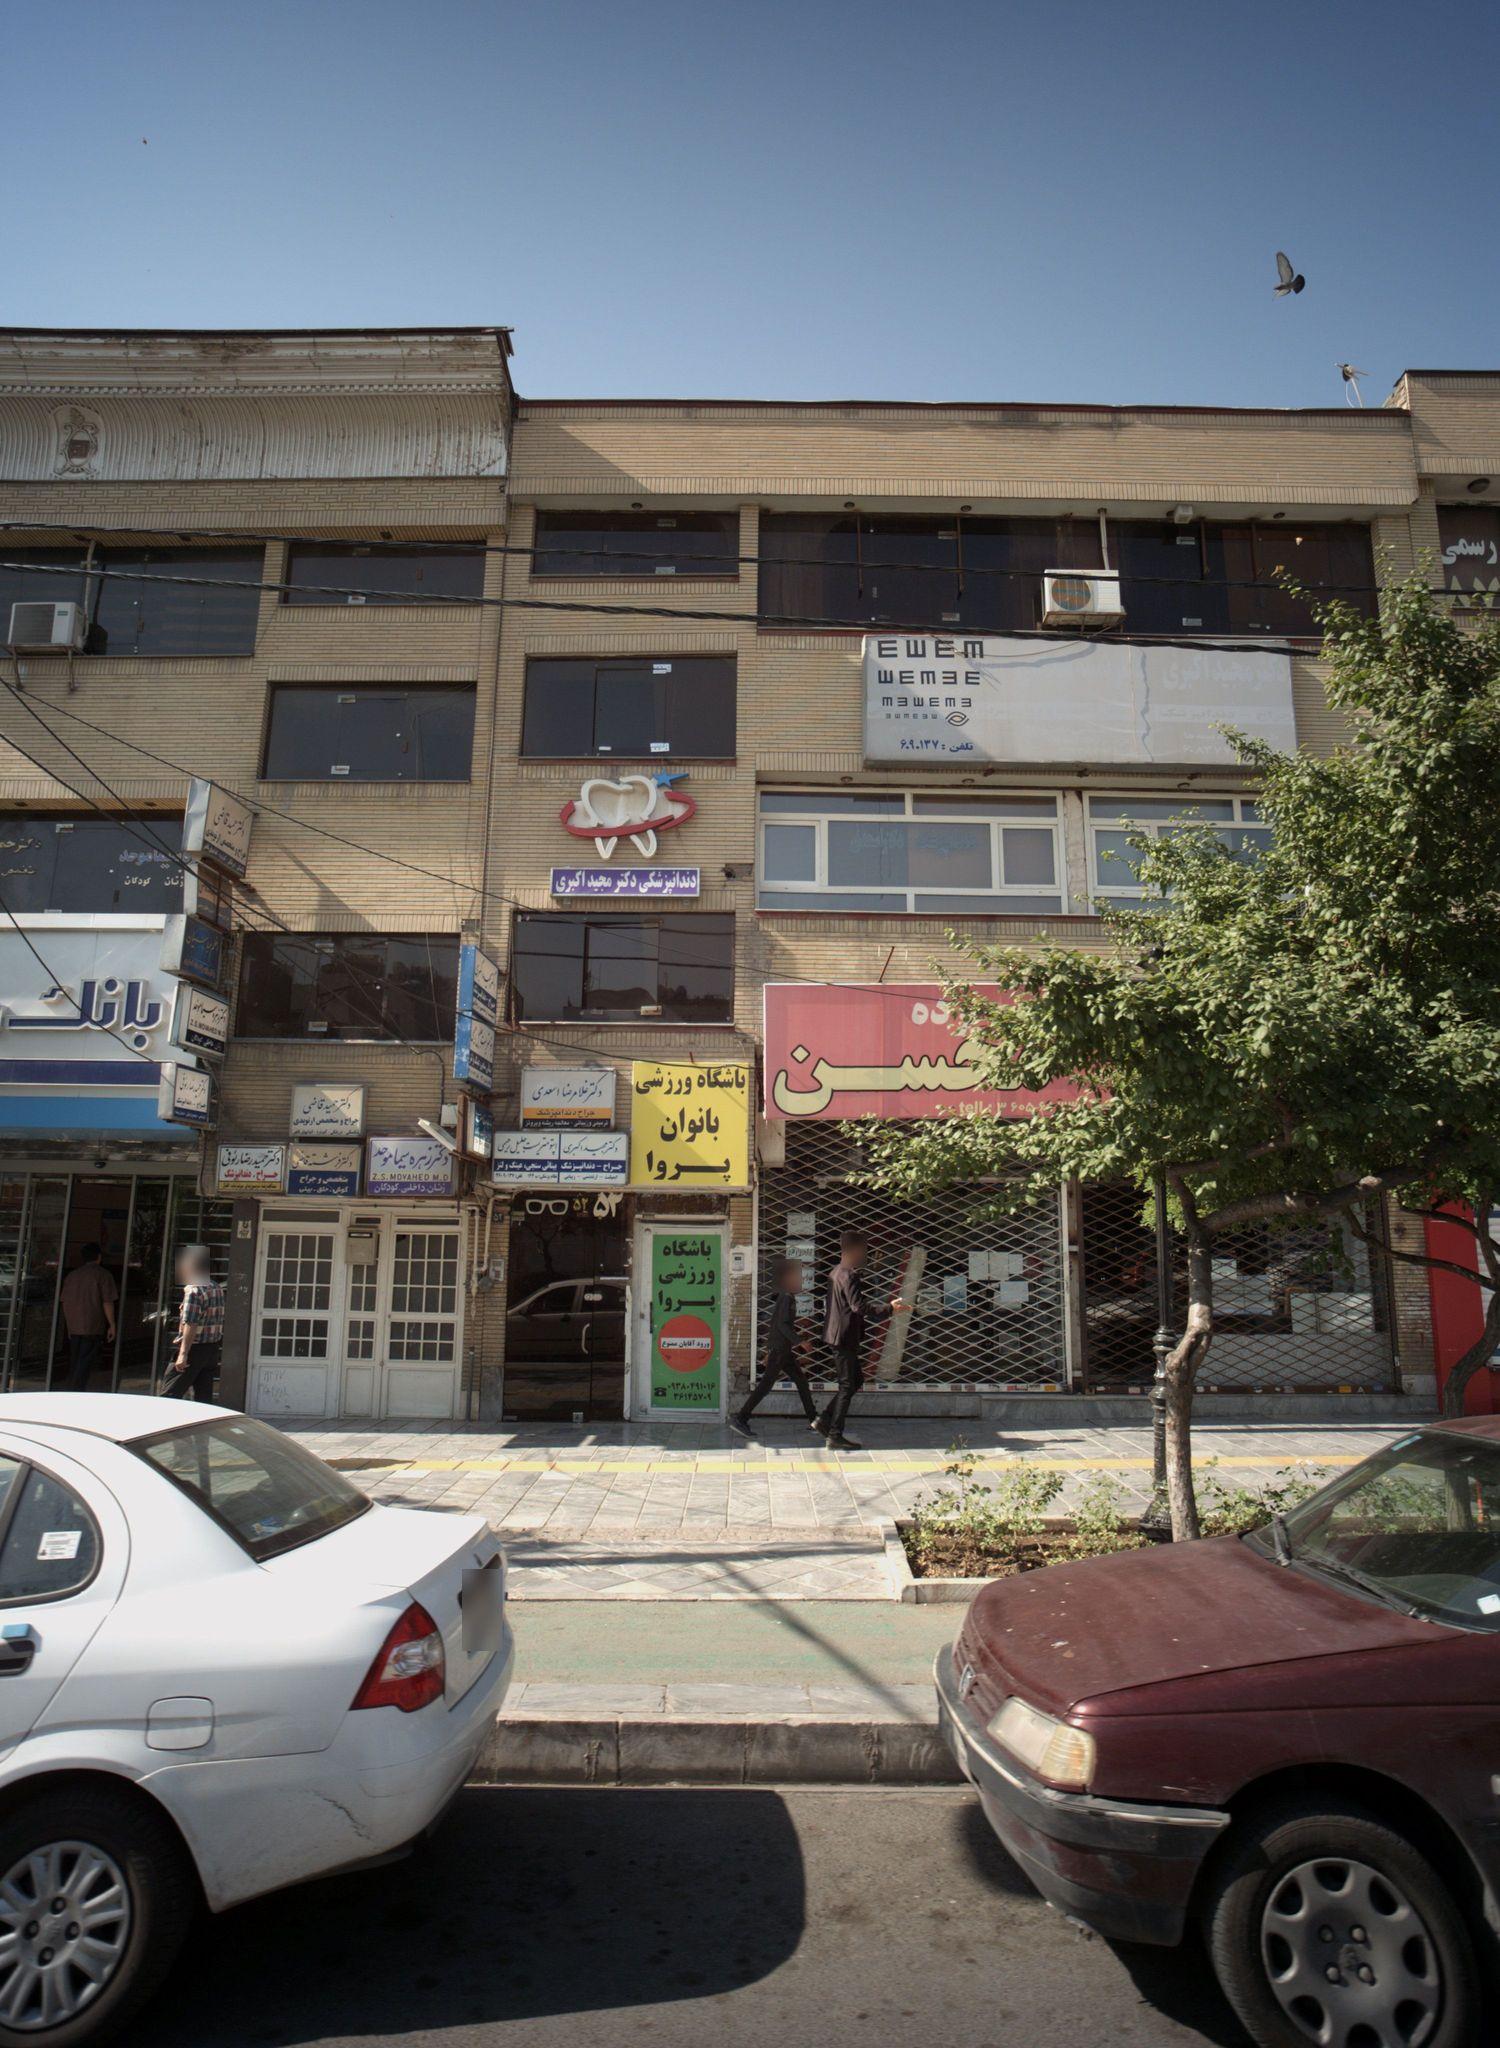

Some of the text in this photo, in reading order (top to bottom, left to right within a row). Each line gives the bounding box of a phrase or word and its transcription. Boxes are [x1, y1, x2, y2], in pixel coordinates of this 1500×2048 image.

[124, 876, 151, 887] کودکان
[556, 871, 697, 894] دندانپزشکی دکتر مجید اکبری
[8, 978, 163, 1052] بانک
[583, 1073, 608, 1103] دکتر
[636, 1068, 746, 1096] باشگاه ورزشی
[302, 1096, 325, 1115] قاضی
[334, 1087, 360, 1113] دکتر
[661, 1106, 720, 1143] بانوان
[264, 1148, 281, 1168] دکتر
[425, 1144, 448, 1170] دکتر
[602, 1162, 622, 1172] جراح
[592, 1191, 624, 1219] ۵۳
[662, 1240, 712, 1261] باشگاه
[658, 1263, 715, 1285] ورزشی
